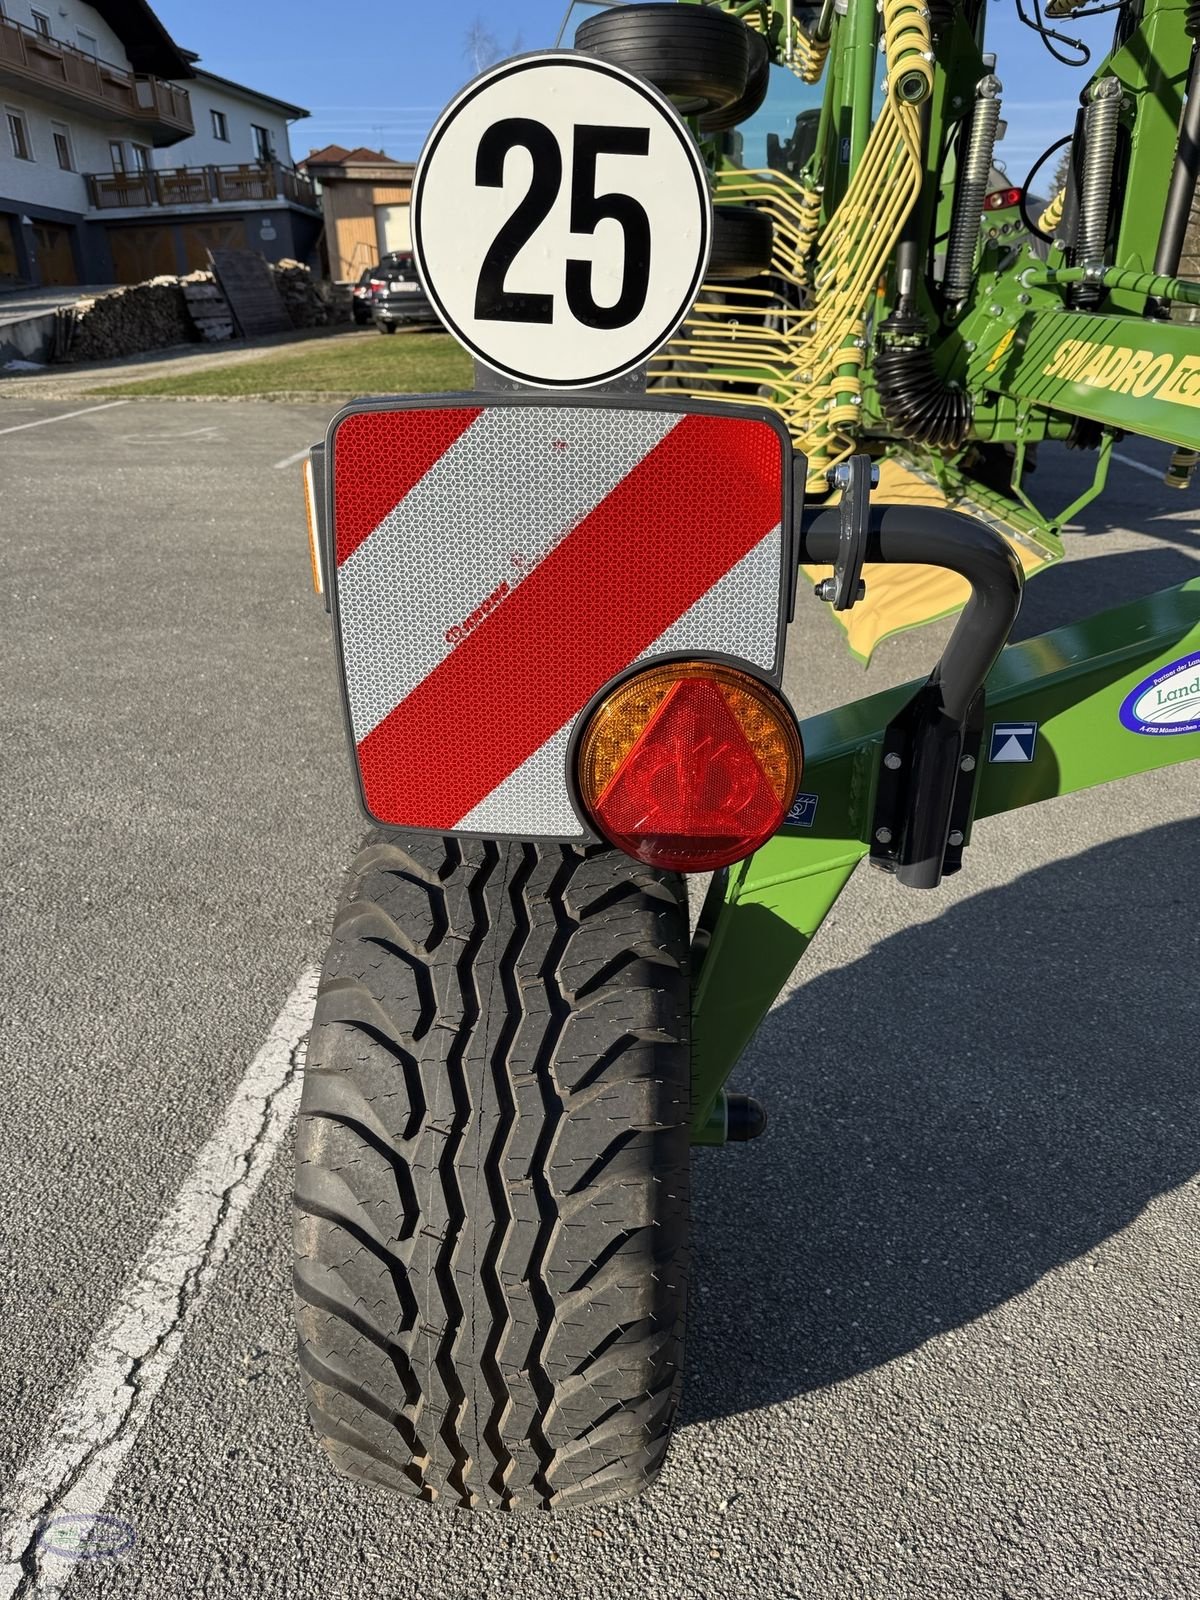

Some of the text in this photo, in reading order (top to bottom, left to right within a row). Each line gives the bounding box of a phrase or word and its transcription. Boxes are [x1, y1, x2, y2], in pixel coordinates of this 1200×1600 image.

[473, 116, 652, 331] 25
[1042, 339, 1174, 398] SWADRO
[1153, 670, 1176, 685] Partner
